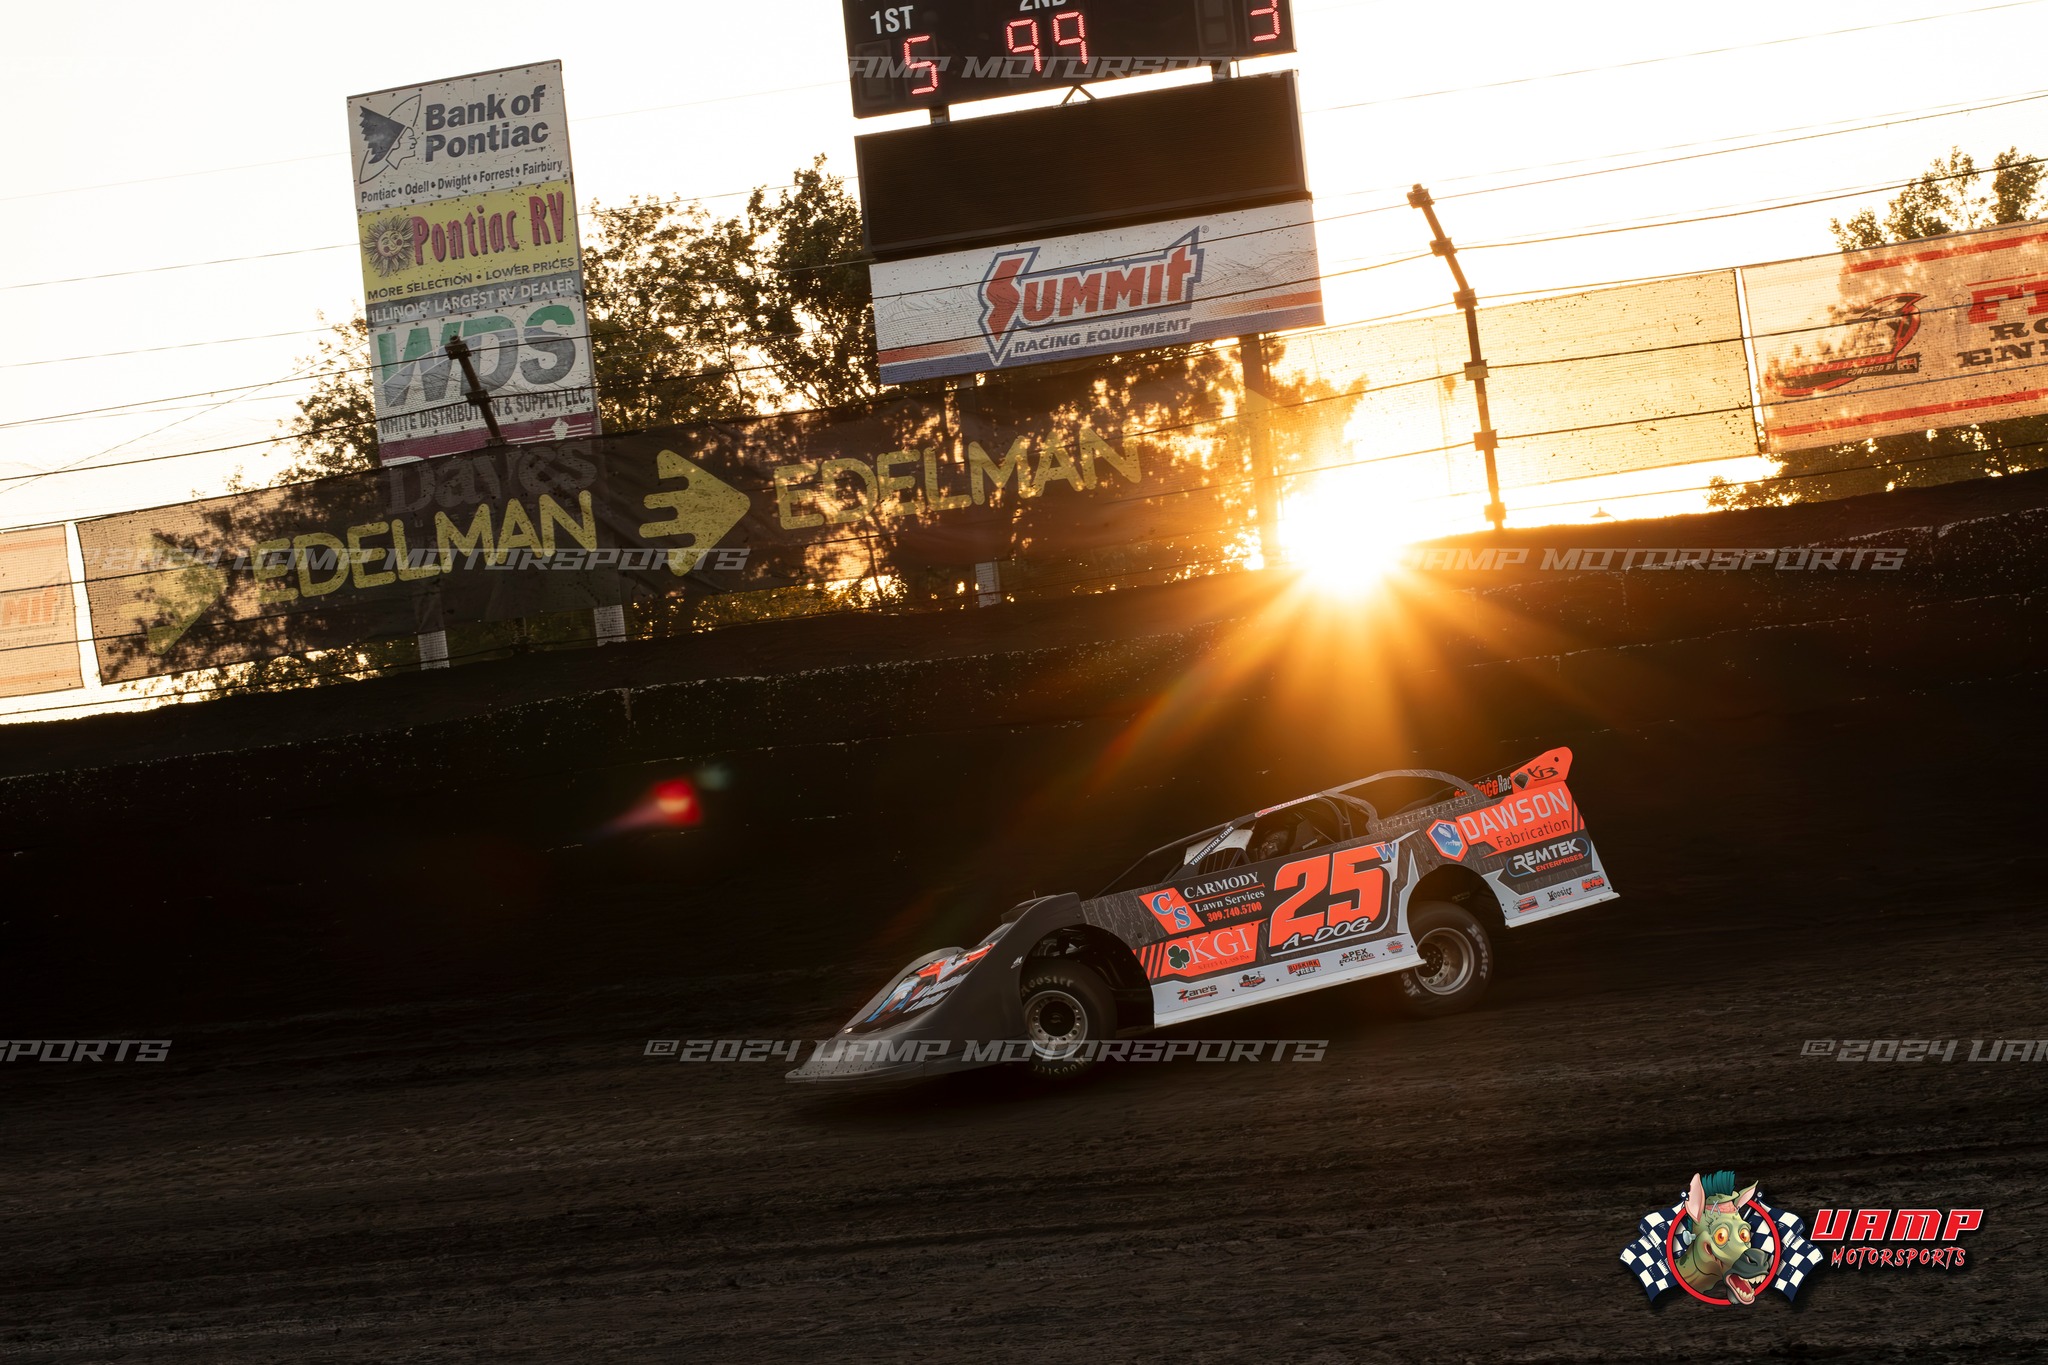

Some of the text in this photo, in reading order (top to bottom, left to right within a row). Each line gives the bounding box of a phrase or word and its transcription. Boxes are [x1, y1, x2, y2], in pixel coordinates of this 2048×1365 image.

[870, 5, 914, 35] 1ST
[1250, 0, 1280, 42] 3
[1006, 11, 1088, 72] 99
[904, 35, 938, 95] 5
[425, 84, 546, 131] Bank of
[425, 122, 549, 162] Pontiac
[361, 160, 563, 203] Pontiac Odell Dwight Forrest Fairbury
[412, 190, 564, 266] Pontiac RV
[367, 257, 575, 300] MORE SELECTION LOWER PRICES
[434, 291, 494, 311] LARGEST
[499, 287, 516, 302] RV
[521, 277, 575, 298] DEALER
[1015, 317, 1191, 354] RACING EQUIPMENT
[377, 304, 576, 407] WDS
[380, 412, 417, 435] WHITE
[420, 401, 500, 428] DISTRIBUTN
[504, 399, 513, 415] &
[774, 427, 1142, 530] EDELMAN
[252, 489, 597, 601] EDELMAN
[1459, 788, 1570, 840] DAWSON
[1496, 819, 1570, 848] Fabrication
[1512, 838, 1581, 873] REMTEK
[1535, 853, 1584, 872] ENTERPRISES
[1184, 872, 1260, 899] CARMODY
[1195, 889, 1265, 913] Lawn Services
[1269, 841, 1385, 948] 25
[1547, 886, 1573, 901] Hoosier
[1206, 901, 1263, 923] 309.740.5700
[1187, 927, 1254, 965] KGI
[1282, 917, 1372, 950] A-DOG
[1177, 984, 1218, 1002] Zane's
